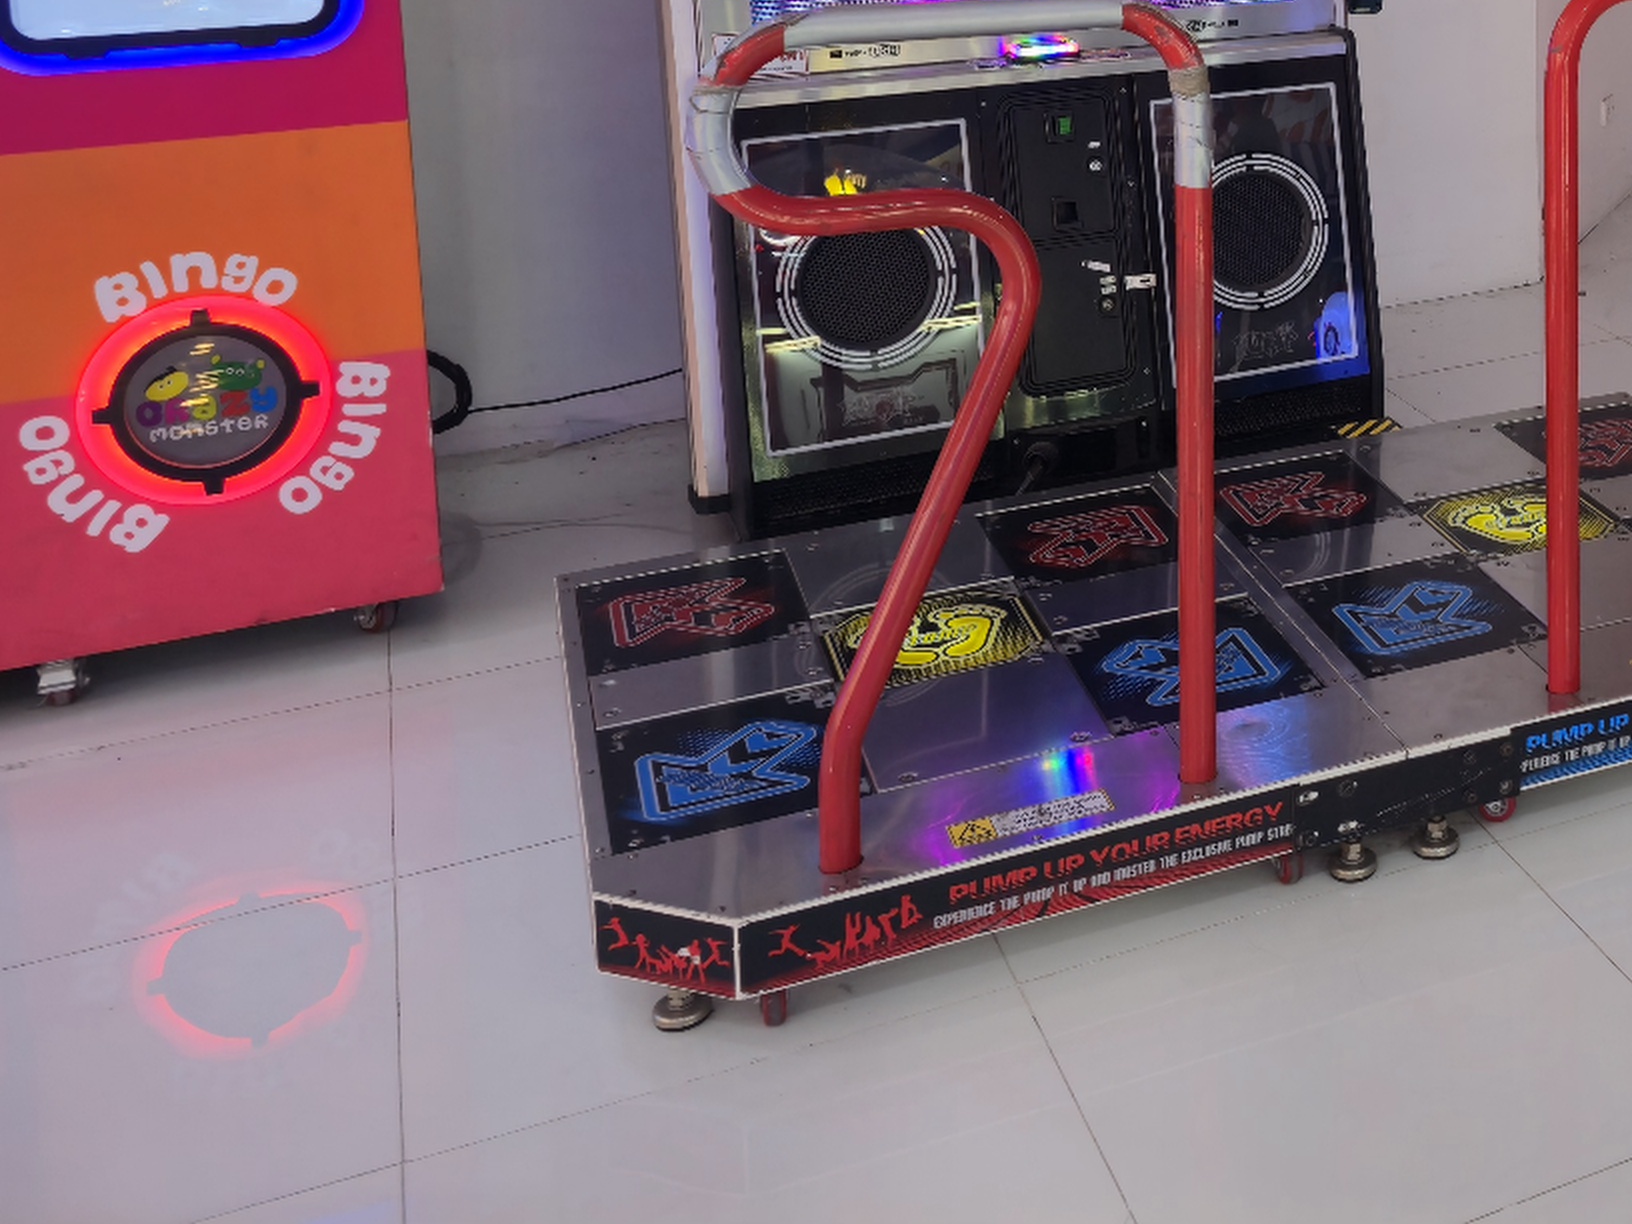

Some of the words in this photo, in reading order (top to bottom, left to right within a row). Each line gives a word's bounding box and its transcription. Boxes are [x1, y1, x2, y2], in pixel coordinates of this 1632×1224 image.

[1526, 722, 1595, 753] PUMP
[1598, 713, 1630, 735] UP
[949, 865, 1038, 904] PUMP
[1044, 854, 1086, 880] UP
[1089, 829, 1171, 869] YOUR
[1174, 802, 1284, 846] ENERGY
[1181, 839, 1233, 864] EXCLUSIVE
